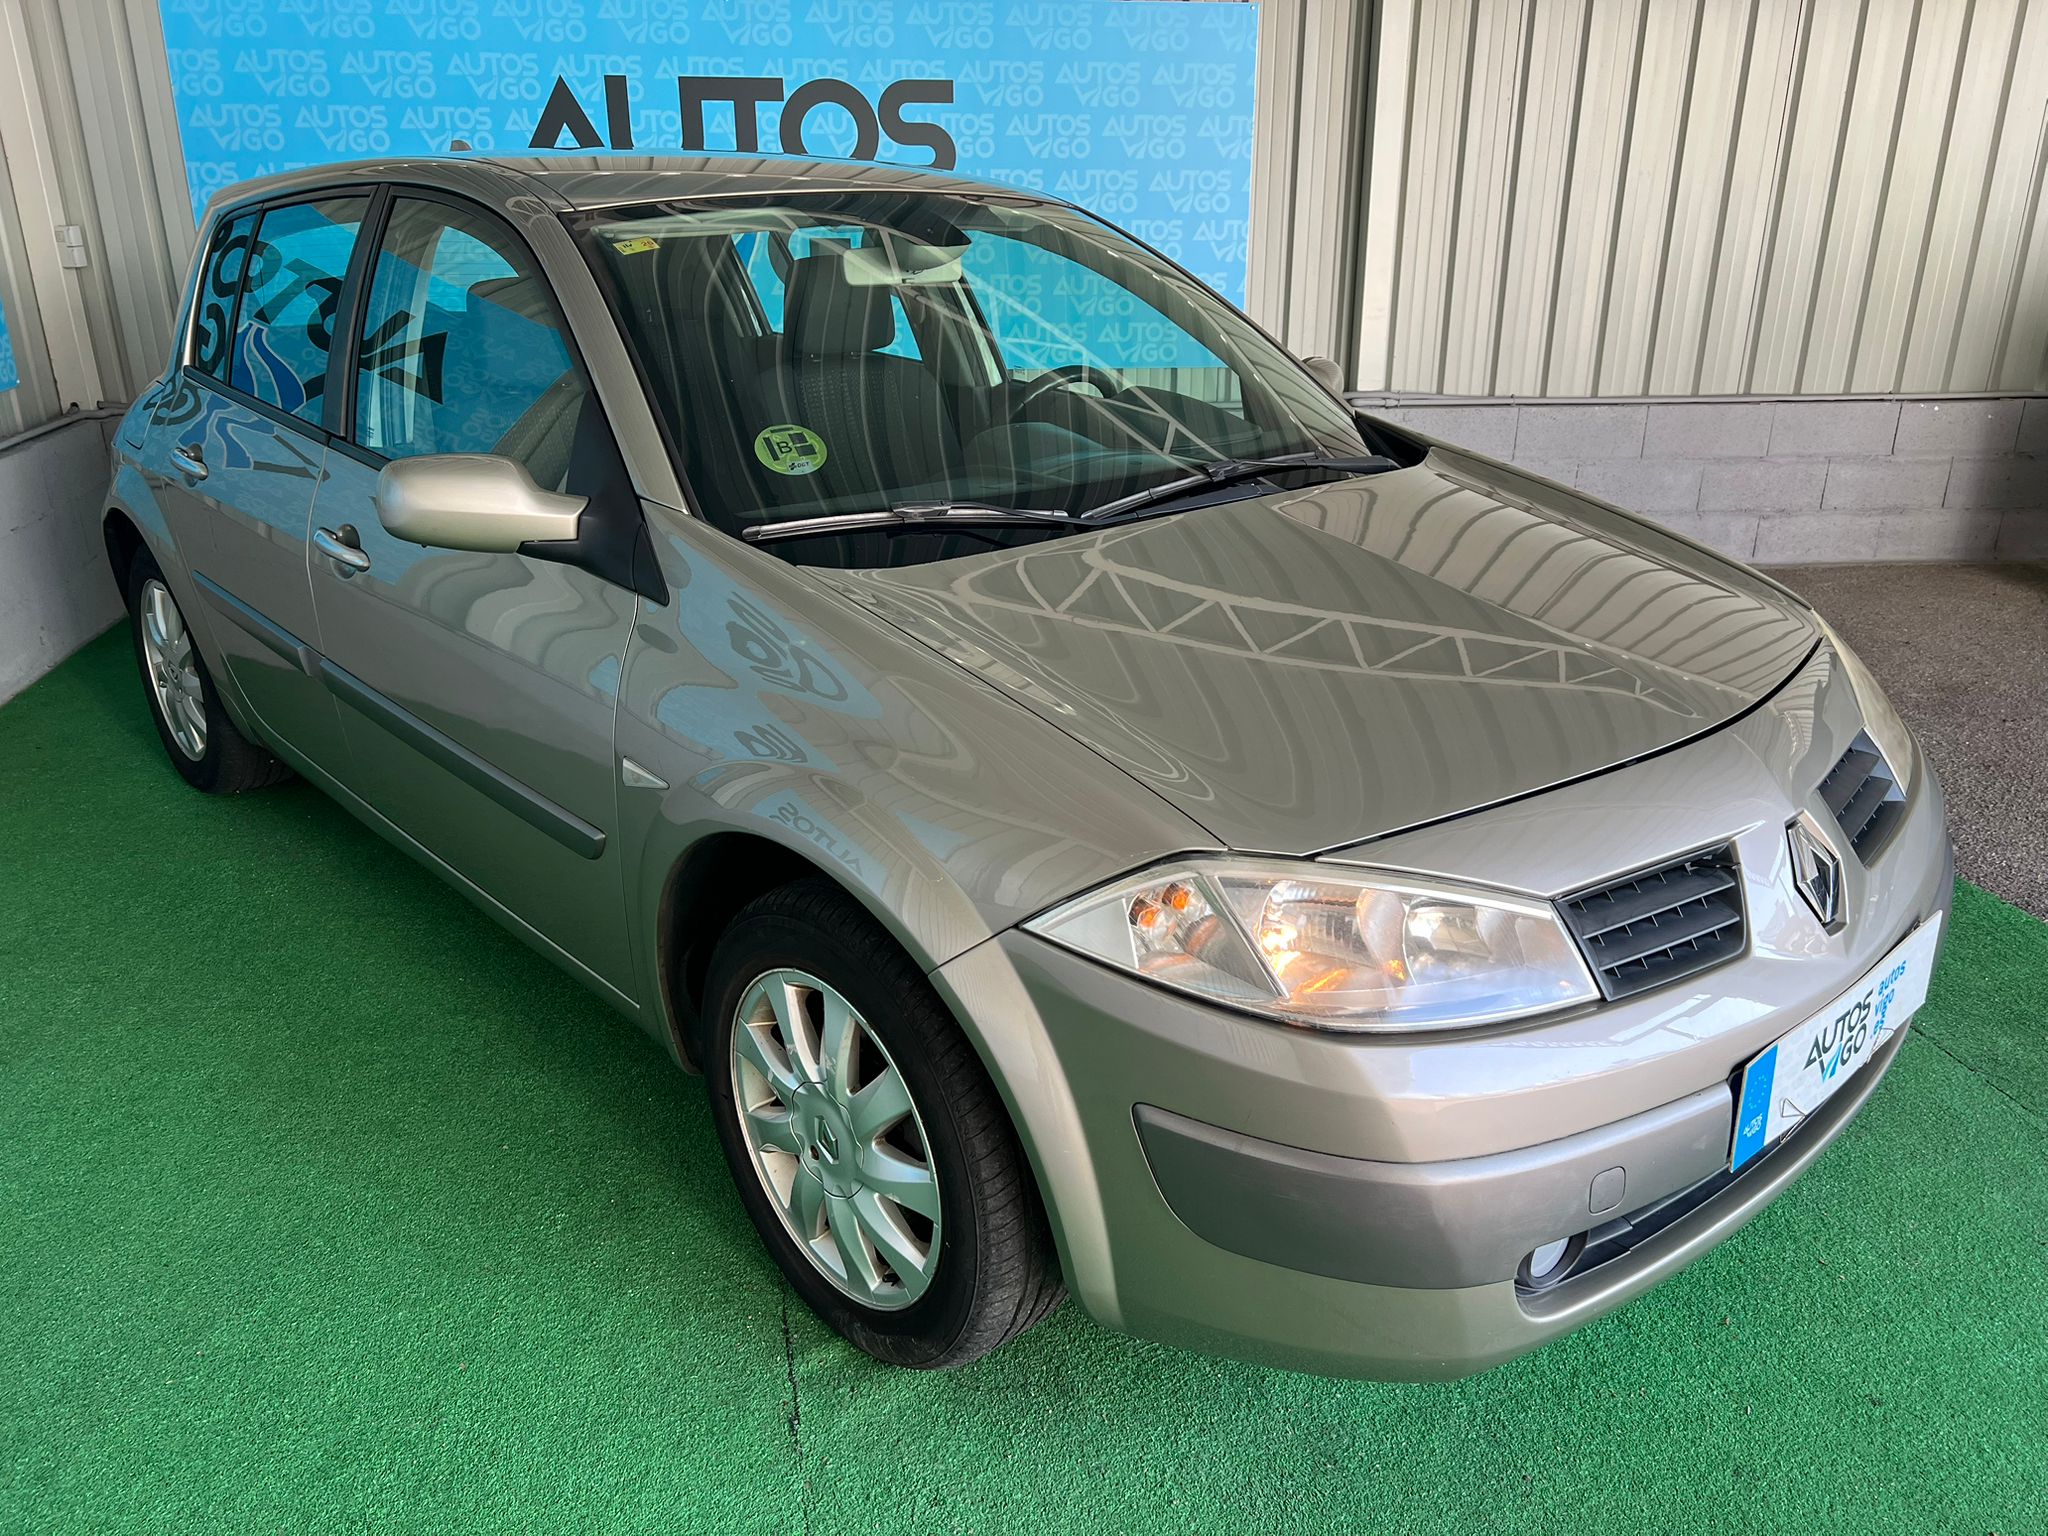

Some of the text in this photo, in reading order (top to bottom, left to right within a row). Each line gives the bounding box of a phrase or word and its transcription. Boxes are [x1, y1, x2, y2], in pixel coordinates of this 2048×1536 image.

[702, 0, 791, 22] AUTOS
[805, 1, 893, 24] AUTOS
[905, 2, 993, 26] AUTOS
[1005, 3, 1092, 26] AUTOS
[233, 50, 328, 73] AUTOS
[340, 51, 433, 74] AUTOS
[447, 53, 539, 75] AUTOS
[552, 54, 642, 78] AUTOS
[958, 60, 1044, 83] AUTOS
[1055, 61, 1141, 84] AUTOS
[1152, 63, 1236, 86] AUTOS
[189, 104, 283, 127] AUTOS
[295, 105, 389, 128] AUTOS
[400, 106, 492, 129] AUTOS
[1006, 113, 1091, 136] AUTOS
[1102, 115, 1186, 137] AUTOS
[1055, 170, 1139, 192] AUTOS
[1148, 170, 1232, 192] AUTOS
[777, 441, 792, 454] B
[1878, 960, 1907, 996] autos
[1803, 988, 1874, 1070] AUTOS
